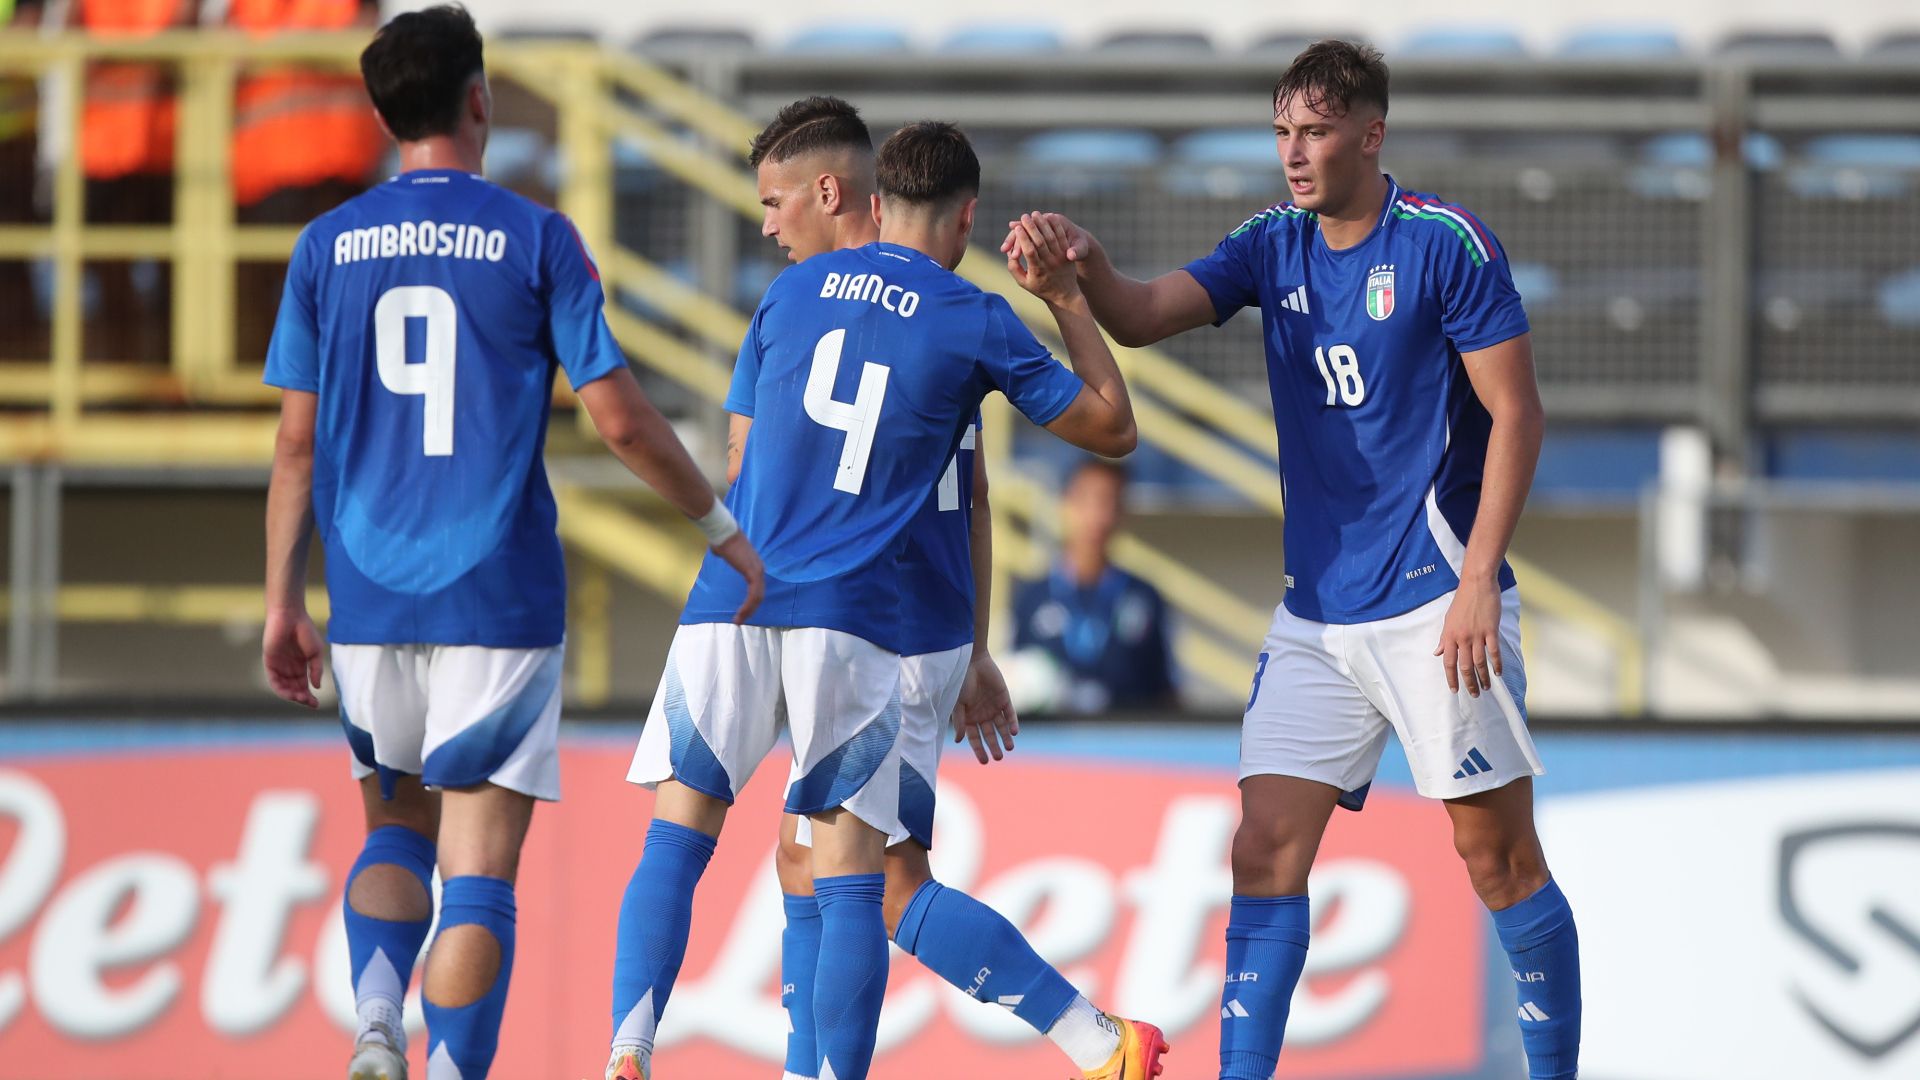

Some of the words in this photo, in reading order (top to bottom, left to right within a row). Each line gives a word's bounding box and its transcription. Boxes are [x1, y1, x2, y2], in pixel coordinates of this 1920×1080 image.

[335, 220, 507, 266] AMBROSINO
[820, 272, 920, 318] BIANCO
[1369, 275, 1392, 288] ITALIA
[375, 285, 457, 456] 9
[1314, 344, 1365, 407] 18
[803, 328, 891, 496] 4
[1405, 563, 1436, 580] HEAT.RDY
